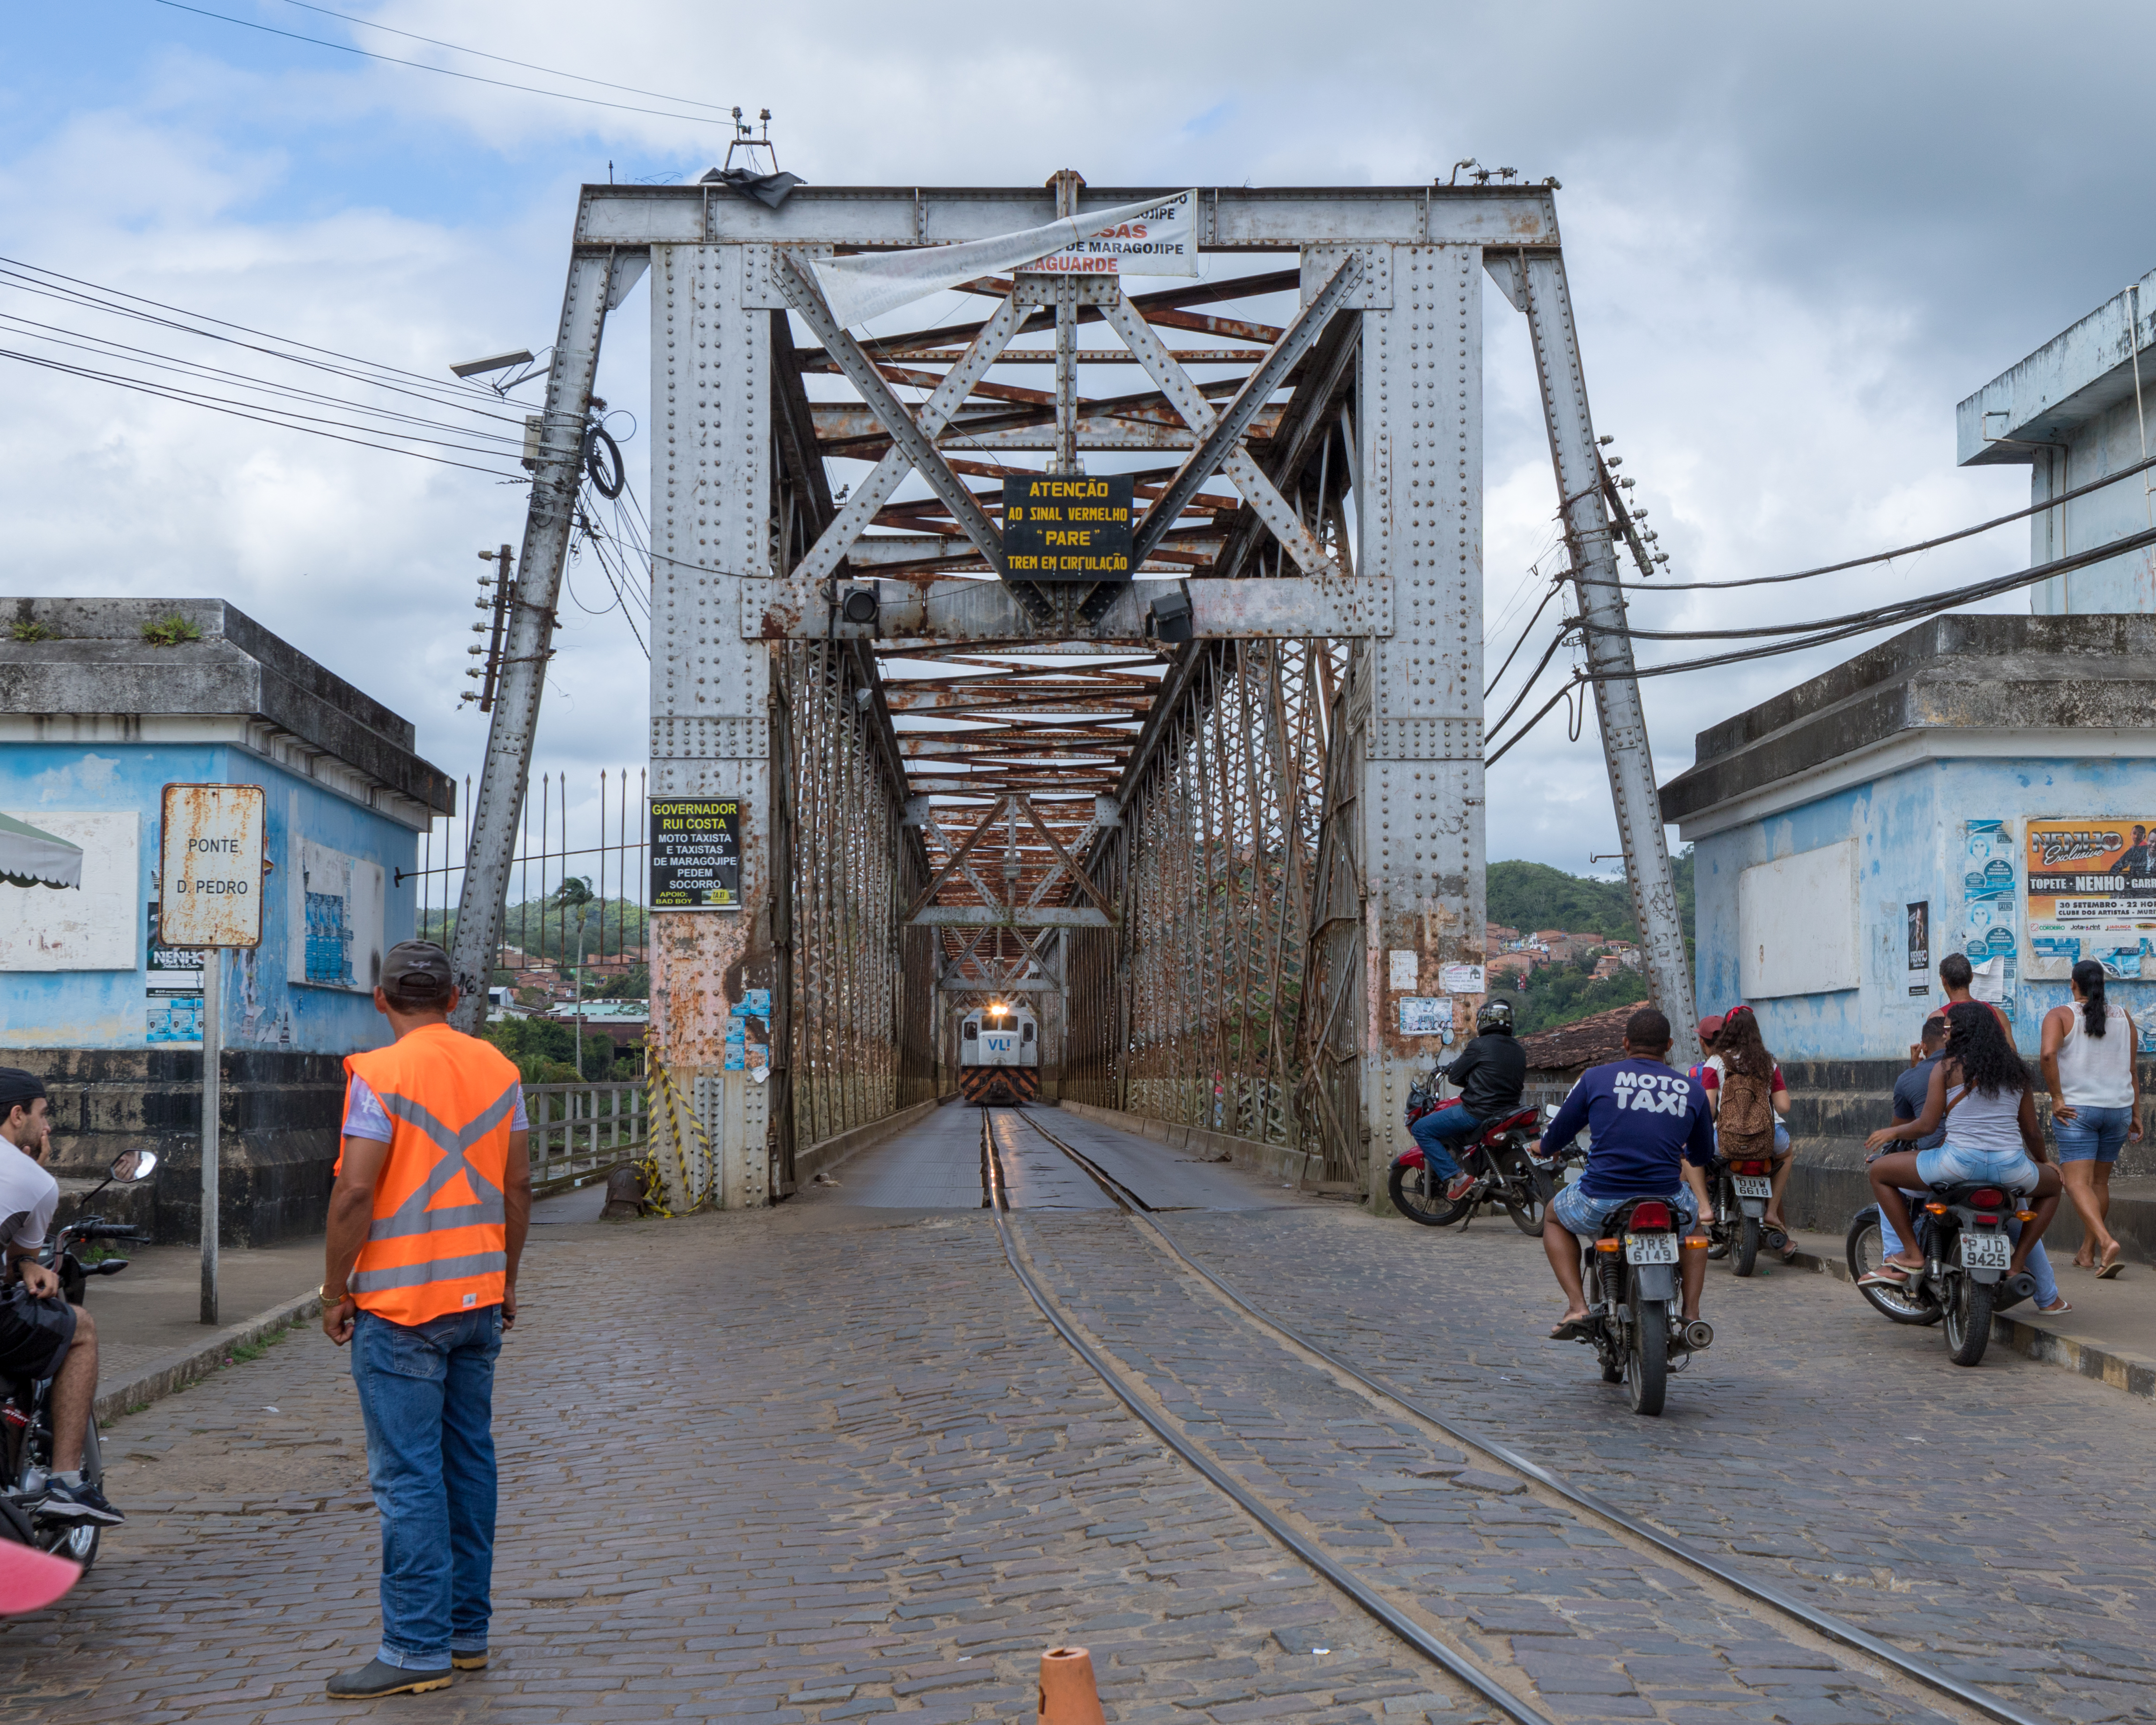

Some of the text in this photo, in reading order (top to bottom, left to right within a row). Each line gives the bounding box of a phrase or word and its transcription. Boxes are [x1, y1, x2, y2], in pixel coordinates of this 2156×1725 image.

[1089, 242, 1183, 254] MARAGOJIPE
[1030, 479, 1108, 499] ATENÇÃO
[1008, 507, 1127, 521] AO SINAL VERMELHO
[1008, 553, 1127, 572] TREM EM CIRCULAÇÃO
[652, 803, 737, 815] GOVERNADOR
[663, 818, 726, 829] RUI COSTA
[690, 834, 732, 842] TAXISTA
[2032, 831, 2123, 852] NENHO
[188, 839, 238, 853] PONTE
[676, 846, 723, 854] TAXISTAS
[654, 857, 736, 866] DE MARAGOJIPE
[2044, 844, 2104, 866] Exclusive
[677, 869, 713, 877] PEDEM
[196, 880, 248, 894] PEDRO
[669, 880, 721, 889] SOCORRO
[2030, 878, 2066, 889] TOPETE
[2075, 876, 2125, 891] NENHO
[1615, 1071, 1690, 1094] MOTO
[1613, 1087, 1687, 1117] TAXI
[1739, 1187, 1769, 1196] 6618
[1636, 1239, 1668, 1250] JRE
[1968, 1239, 2004, 1253] PJD
[1633, 1250, 1671, 1261] 6149
[1967, 1252, 2006, 1267] 9425
